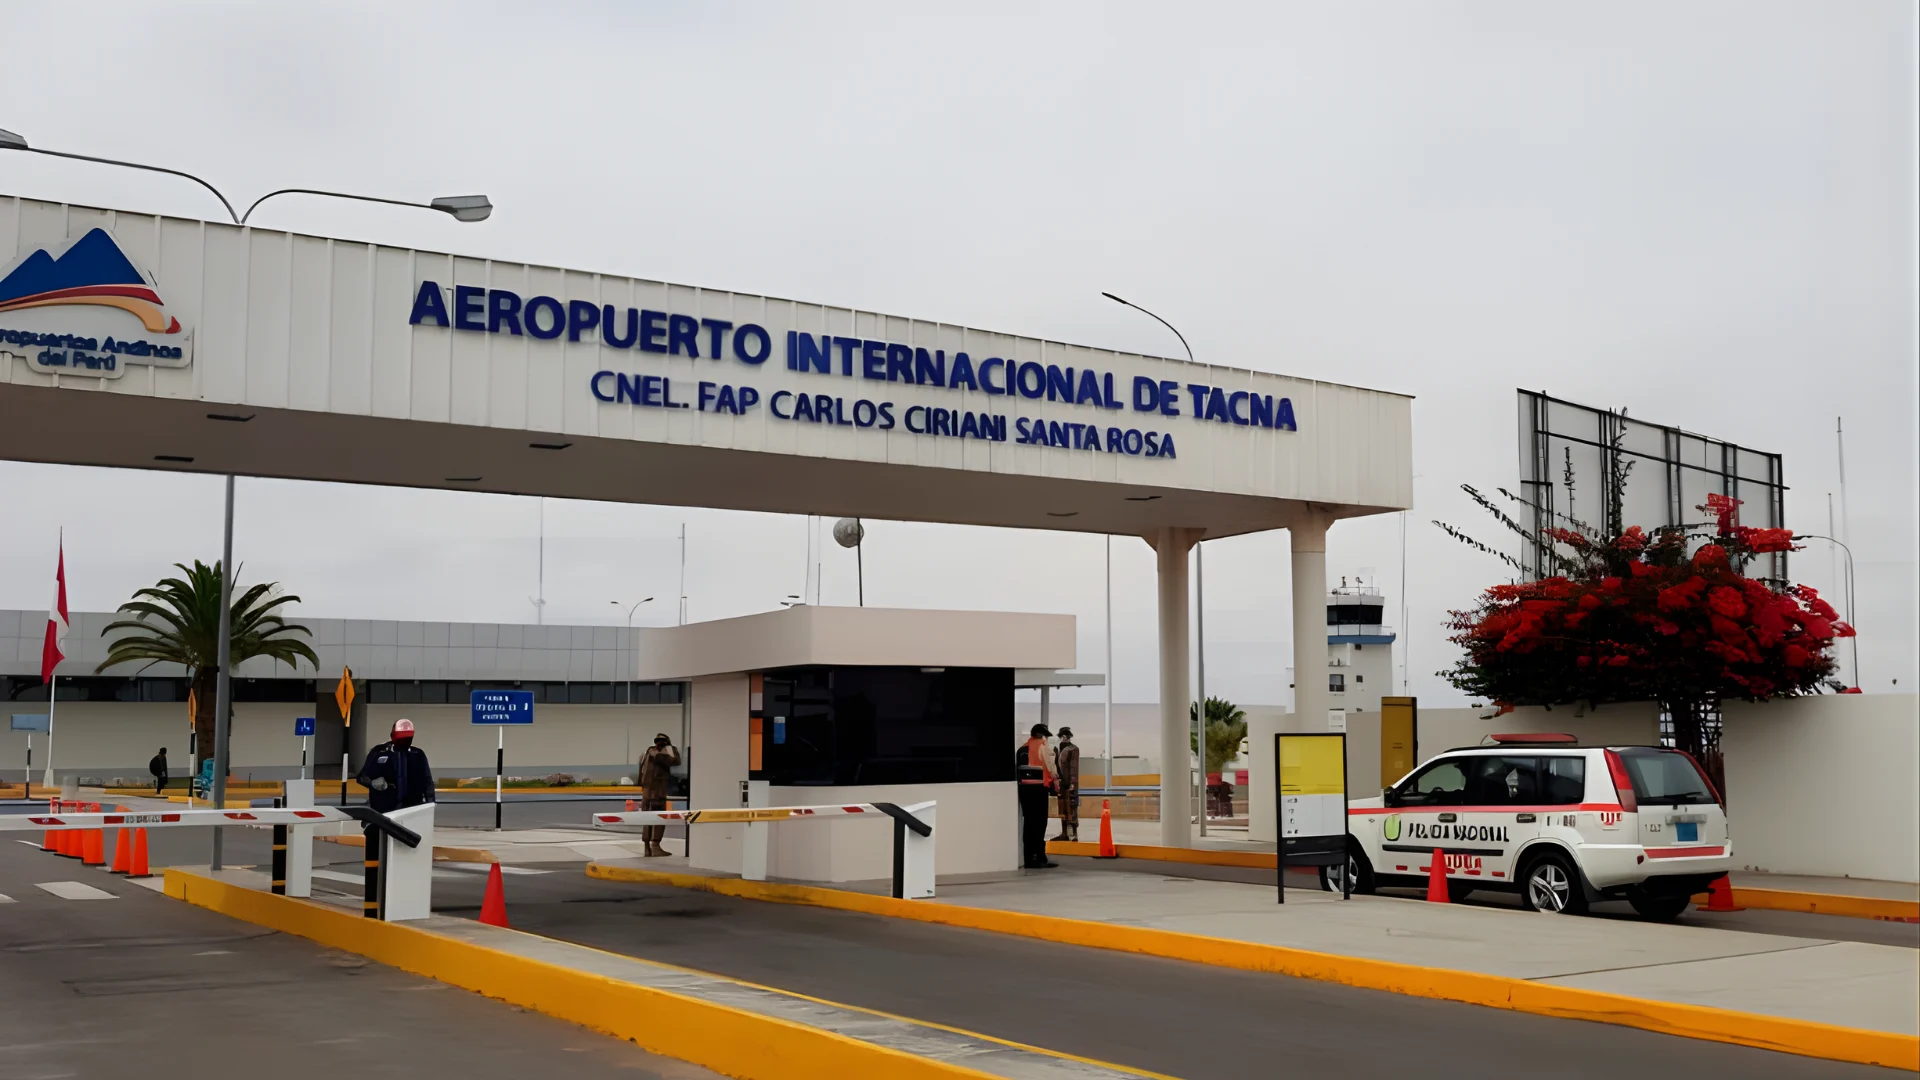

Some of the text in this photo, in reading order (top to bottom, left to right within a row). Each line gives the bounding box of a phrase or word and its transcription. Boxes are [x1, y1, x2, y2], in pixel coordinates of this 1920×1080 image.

[409, 280, 1297, 432] AEROPUERTO INTERNACIONAL DE TACNA
[590, 370, 1177, 460] CNEL. FAP CARLOS CIRIANI SANTA ROSA
